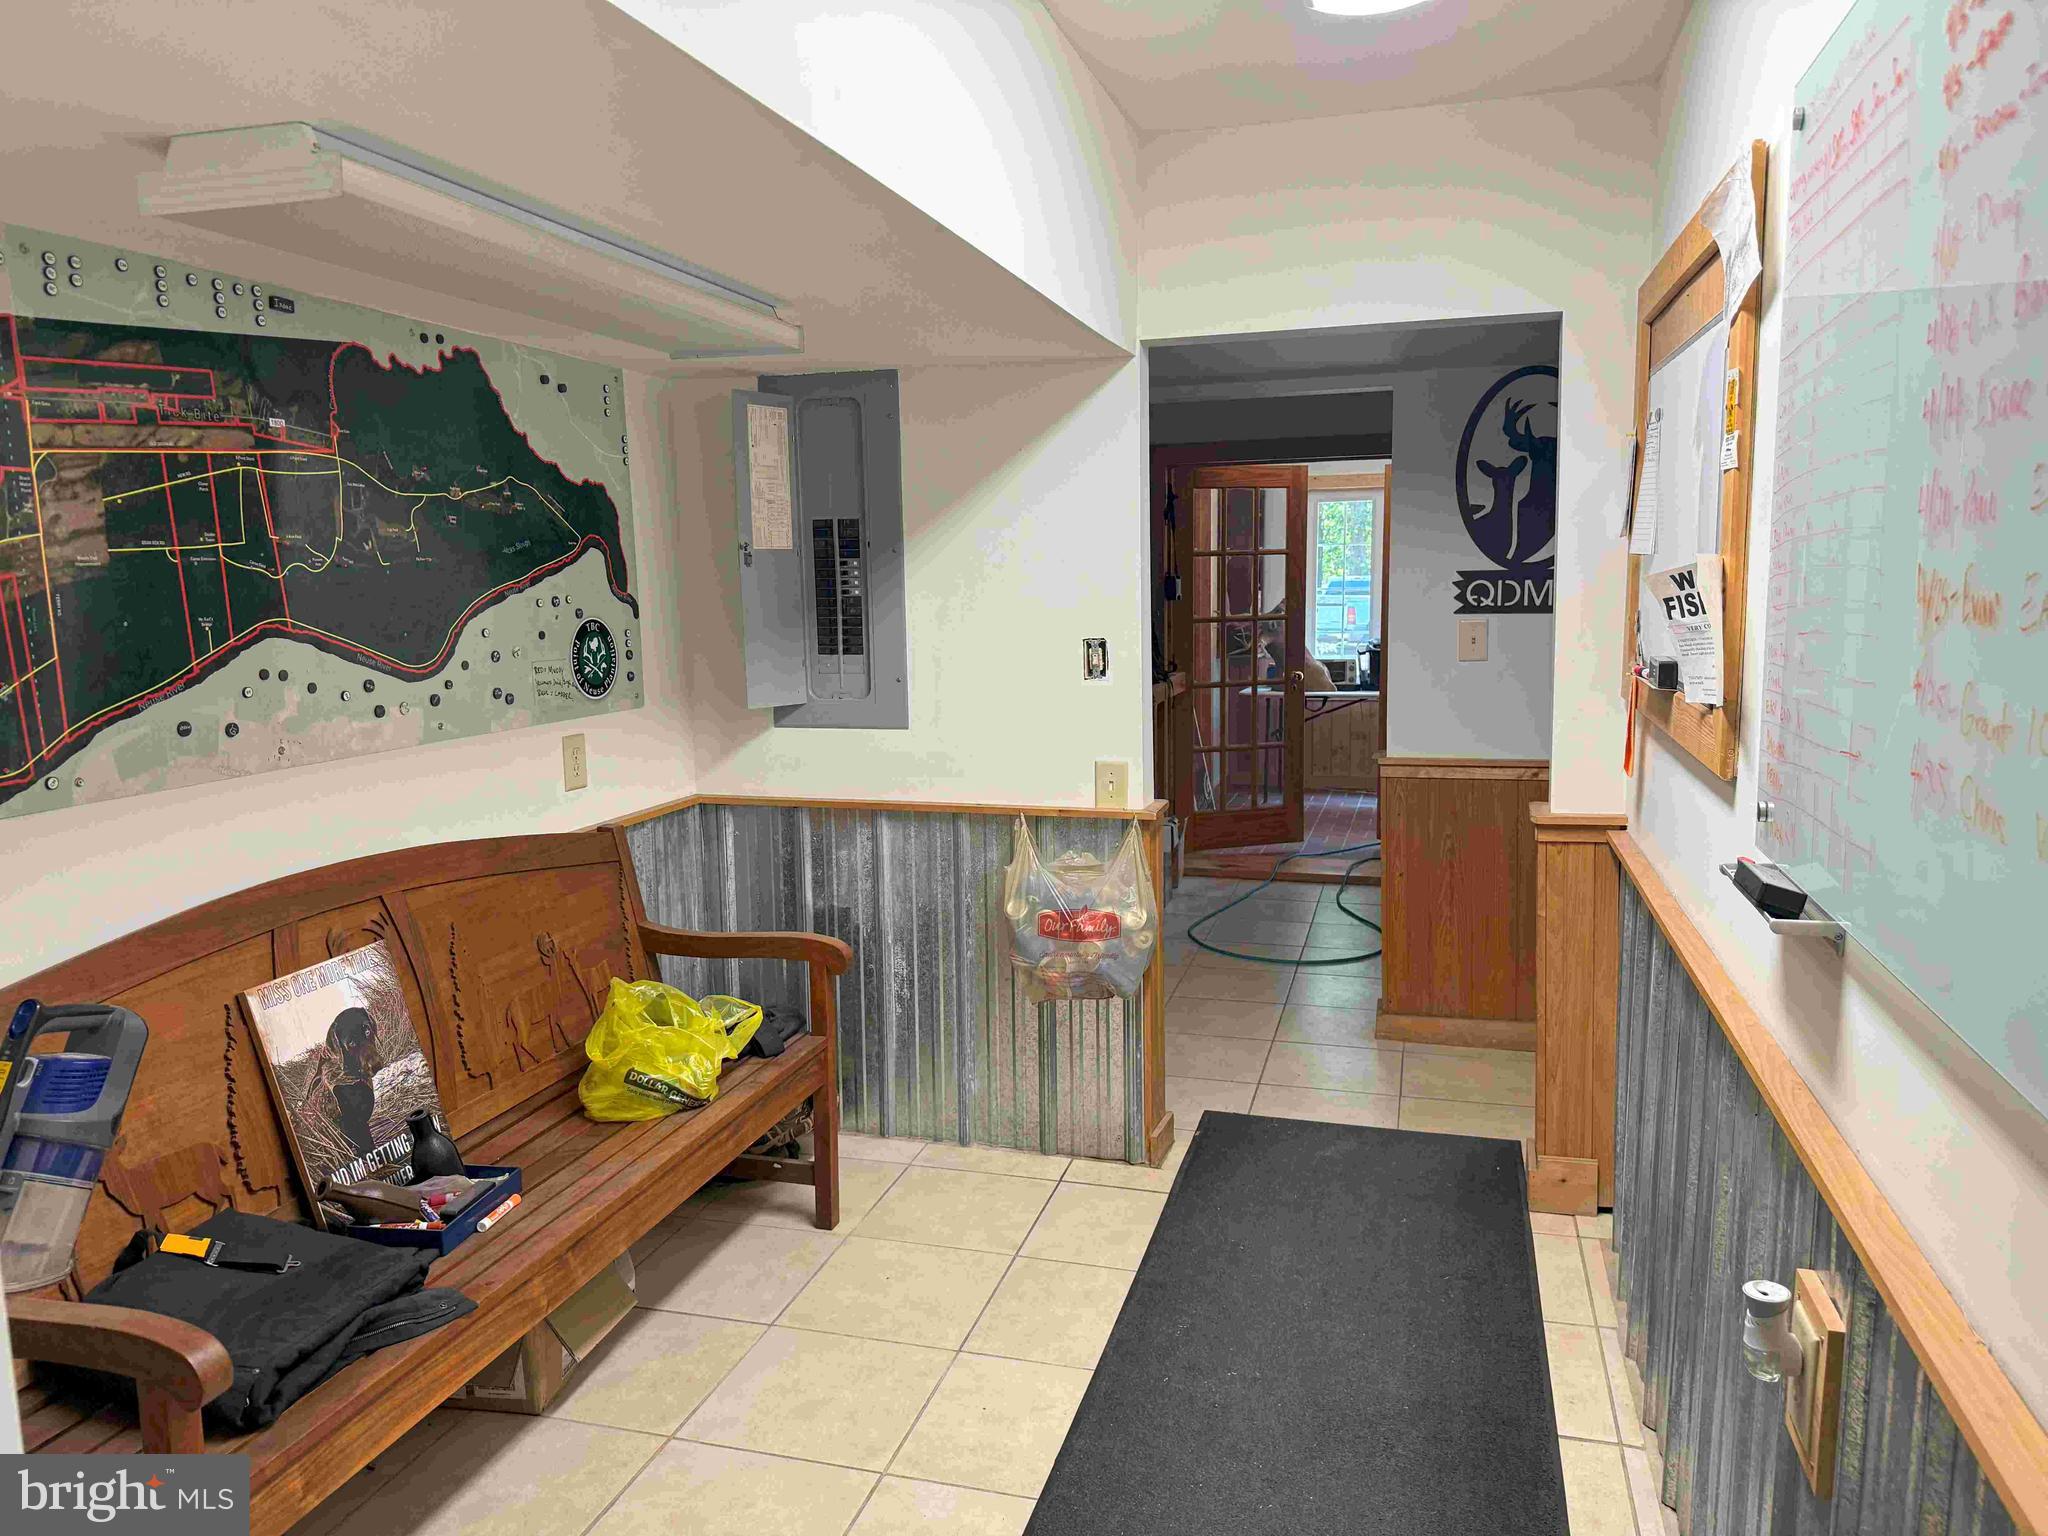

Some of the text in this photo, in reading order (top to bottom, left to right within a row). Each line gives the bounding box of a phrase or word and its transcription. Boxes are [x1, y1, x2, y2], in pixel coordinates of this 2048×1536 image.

[194, 408, 220, 421] Bite
[585, 621, 601, 632] TBC
[357, 653, 376, 666] Neuse
[572, 634, 617, 696] Point of Neuse Plantation
[138, 695, 165, 711] Neuse
[1960, 682, 2015, 753] Grant
[1960, 775, 2009, 846] Chris
[1044, 918, 1068, 932] Our
[256, 948, 377, 1011] MISS ONE MORE TIME
[629, 1071, 669, 1096] DOLLAR
[331, 1133, 411, 1186] ND IM GETTING
